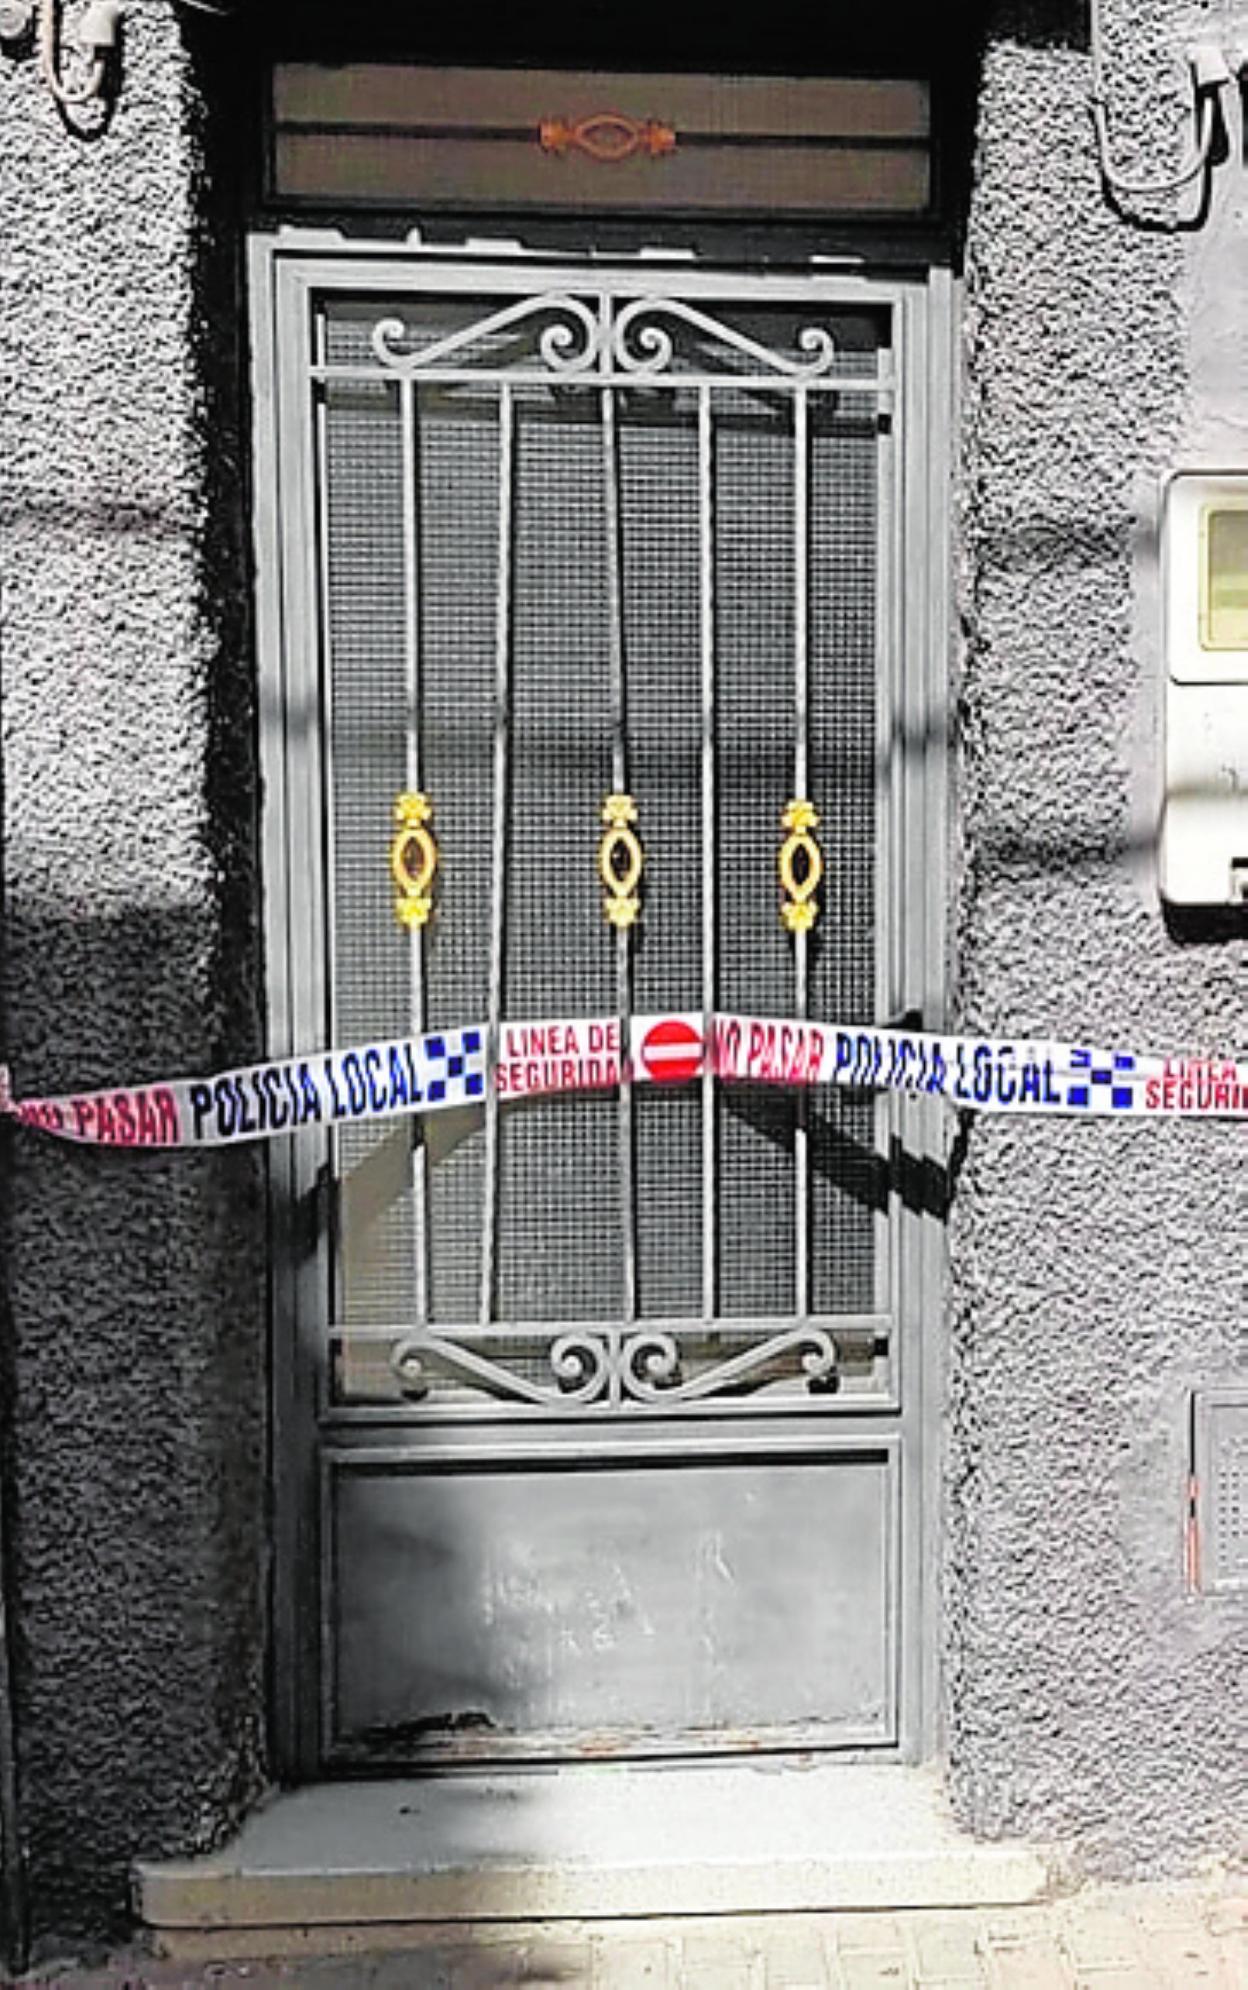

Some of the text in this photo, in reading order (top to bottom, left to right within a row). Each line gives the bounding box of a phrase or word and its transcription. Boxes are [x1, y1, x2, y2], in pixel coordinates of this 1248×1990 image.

[507, 1022, 620, 1057] LINEA DE
[748, 1021, 825, 1084] PASAR
[832, 1031, 1061, 1104] POLICIA LOCAL
[70, 1086, 181, 1143] PASAR
[190, 1042, 424, 1140] POLICIA LOCAL
